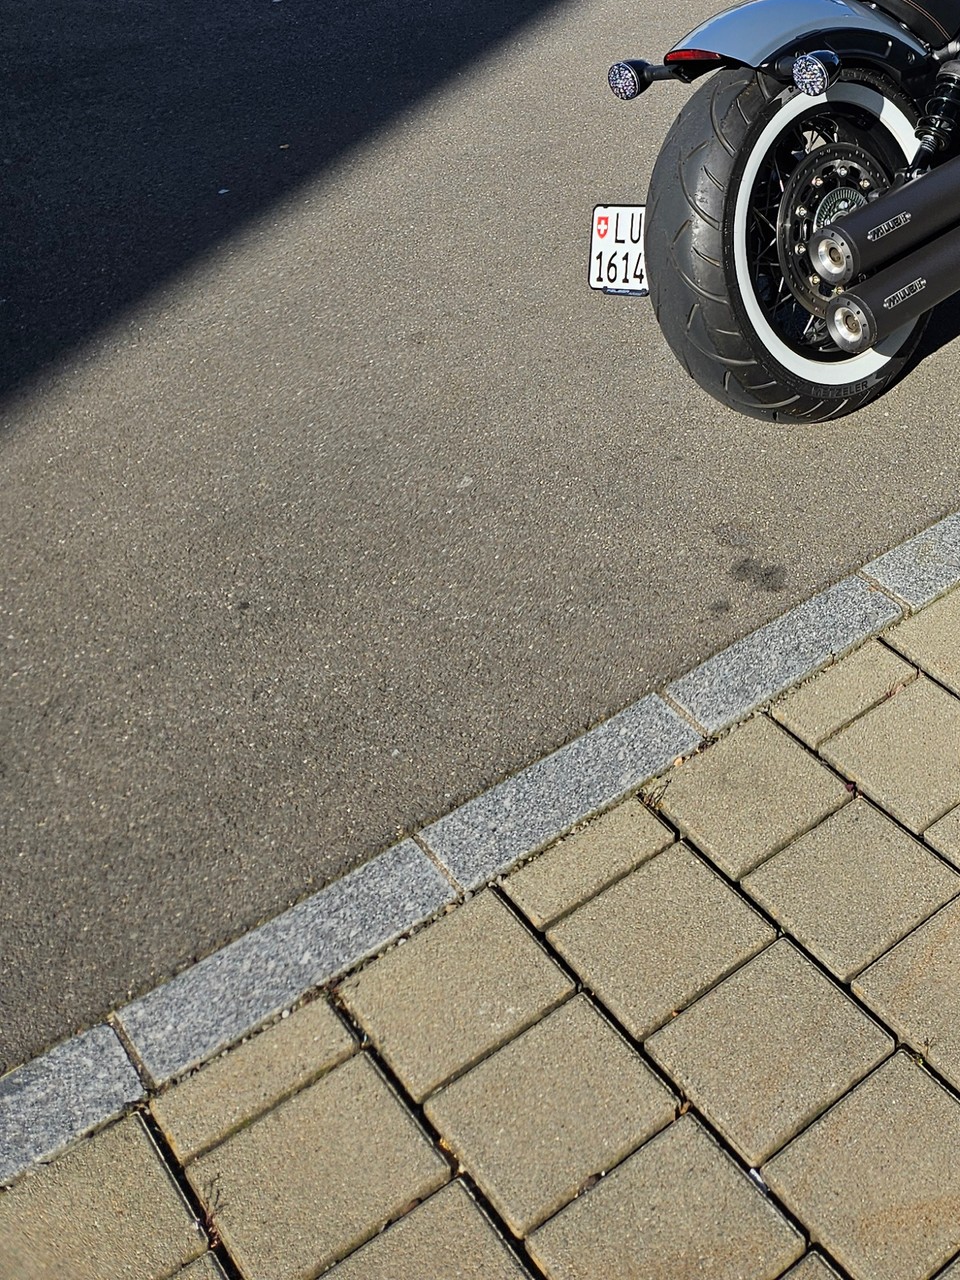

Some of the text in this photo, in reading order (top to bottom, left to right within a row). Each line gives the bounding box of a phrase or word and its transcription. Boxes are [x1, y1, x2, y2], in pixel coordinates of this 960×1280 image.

[614, 212, 643, 244] LU
[595, 250, 645, 284] 1614
[810, 380, 869, 398] METZELER
